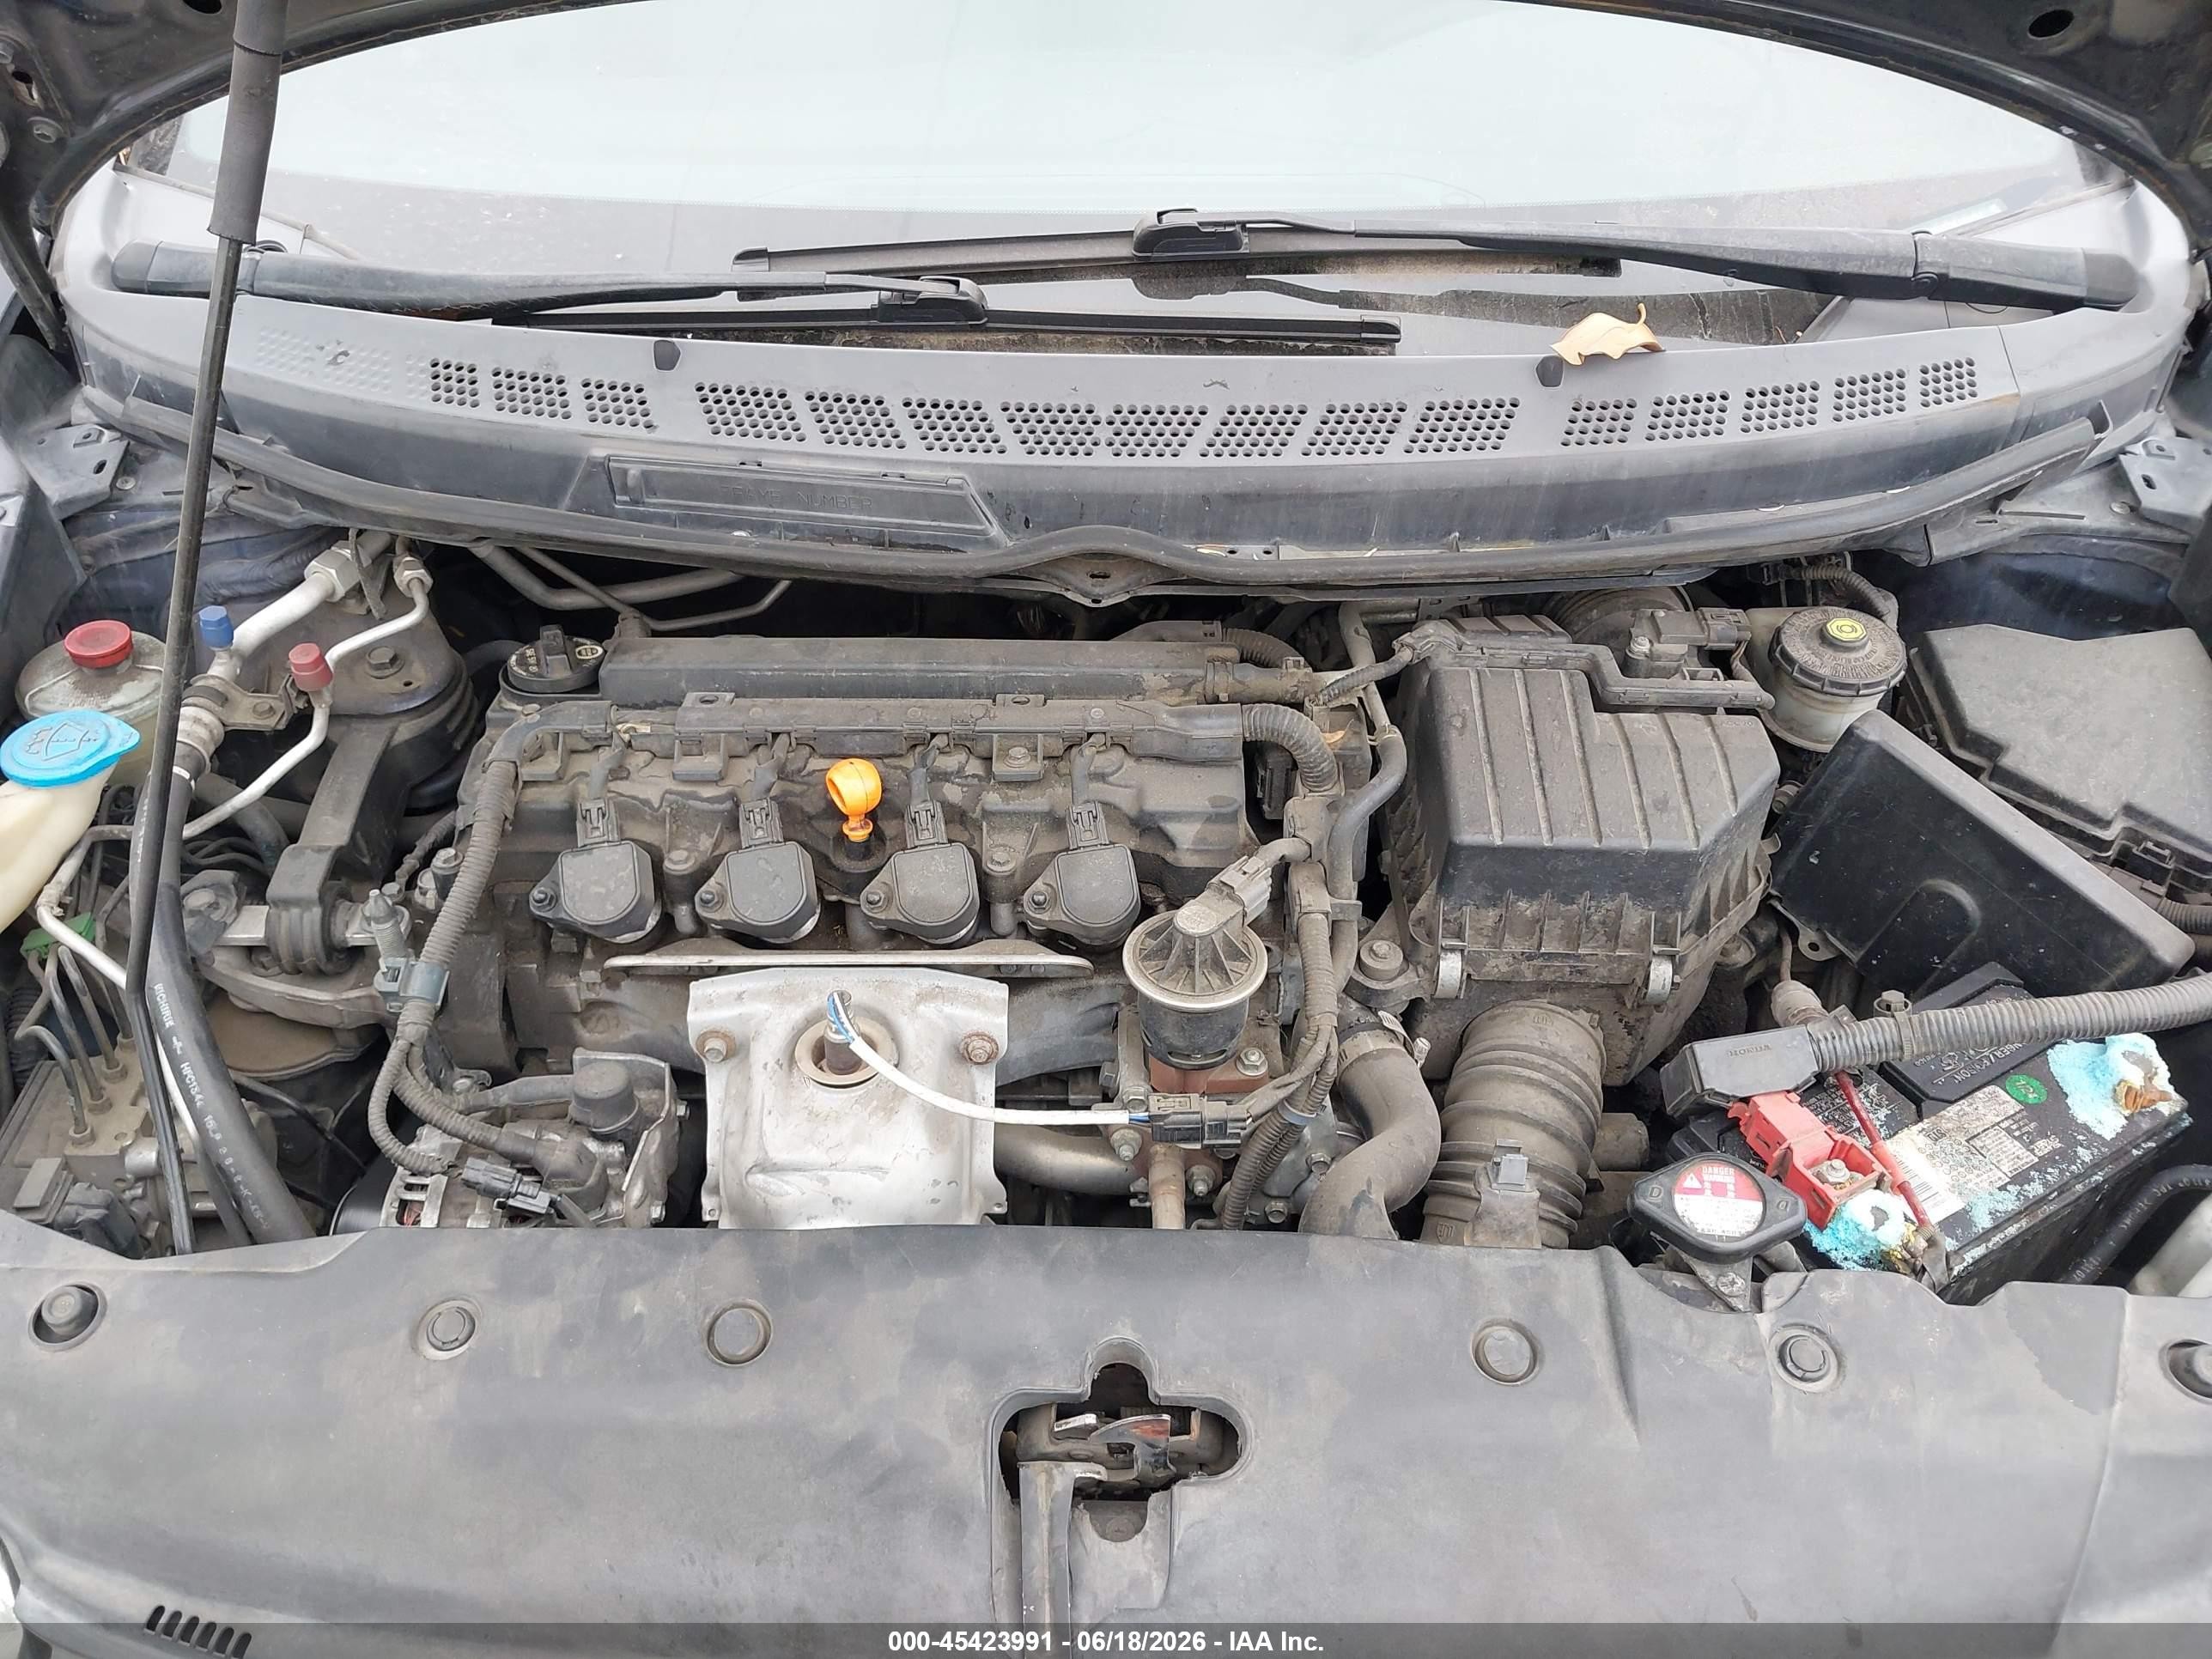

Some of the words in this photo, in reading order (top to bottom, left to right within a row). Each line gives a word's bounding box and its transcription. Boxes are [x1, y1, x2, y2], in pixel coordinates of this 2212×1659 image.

[796, 490, 872, 510] NUMBER
[1728, 1044, 1773, 1057] HONDA
[1702, 1165, 1735, 1176] DANGER
